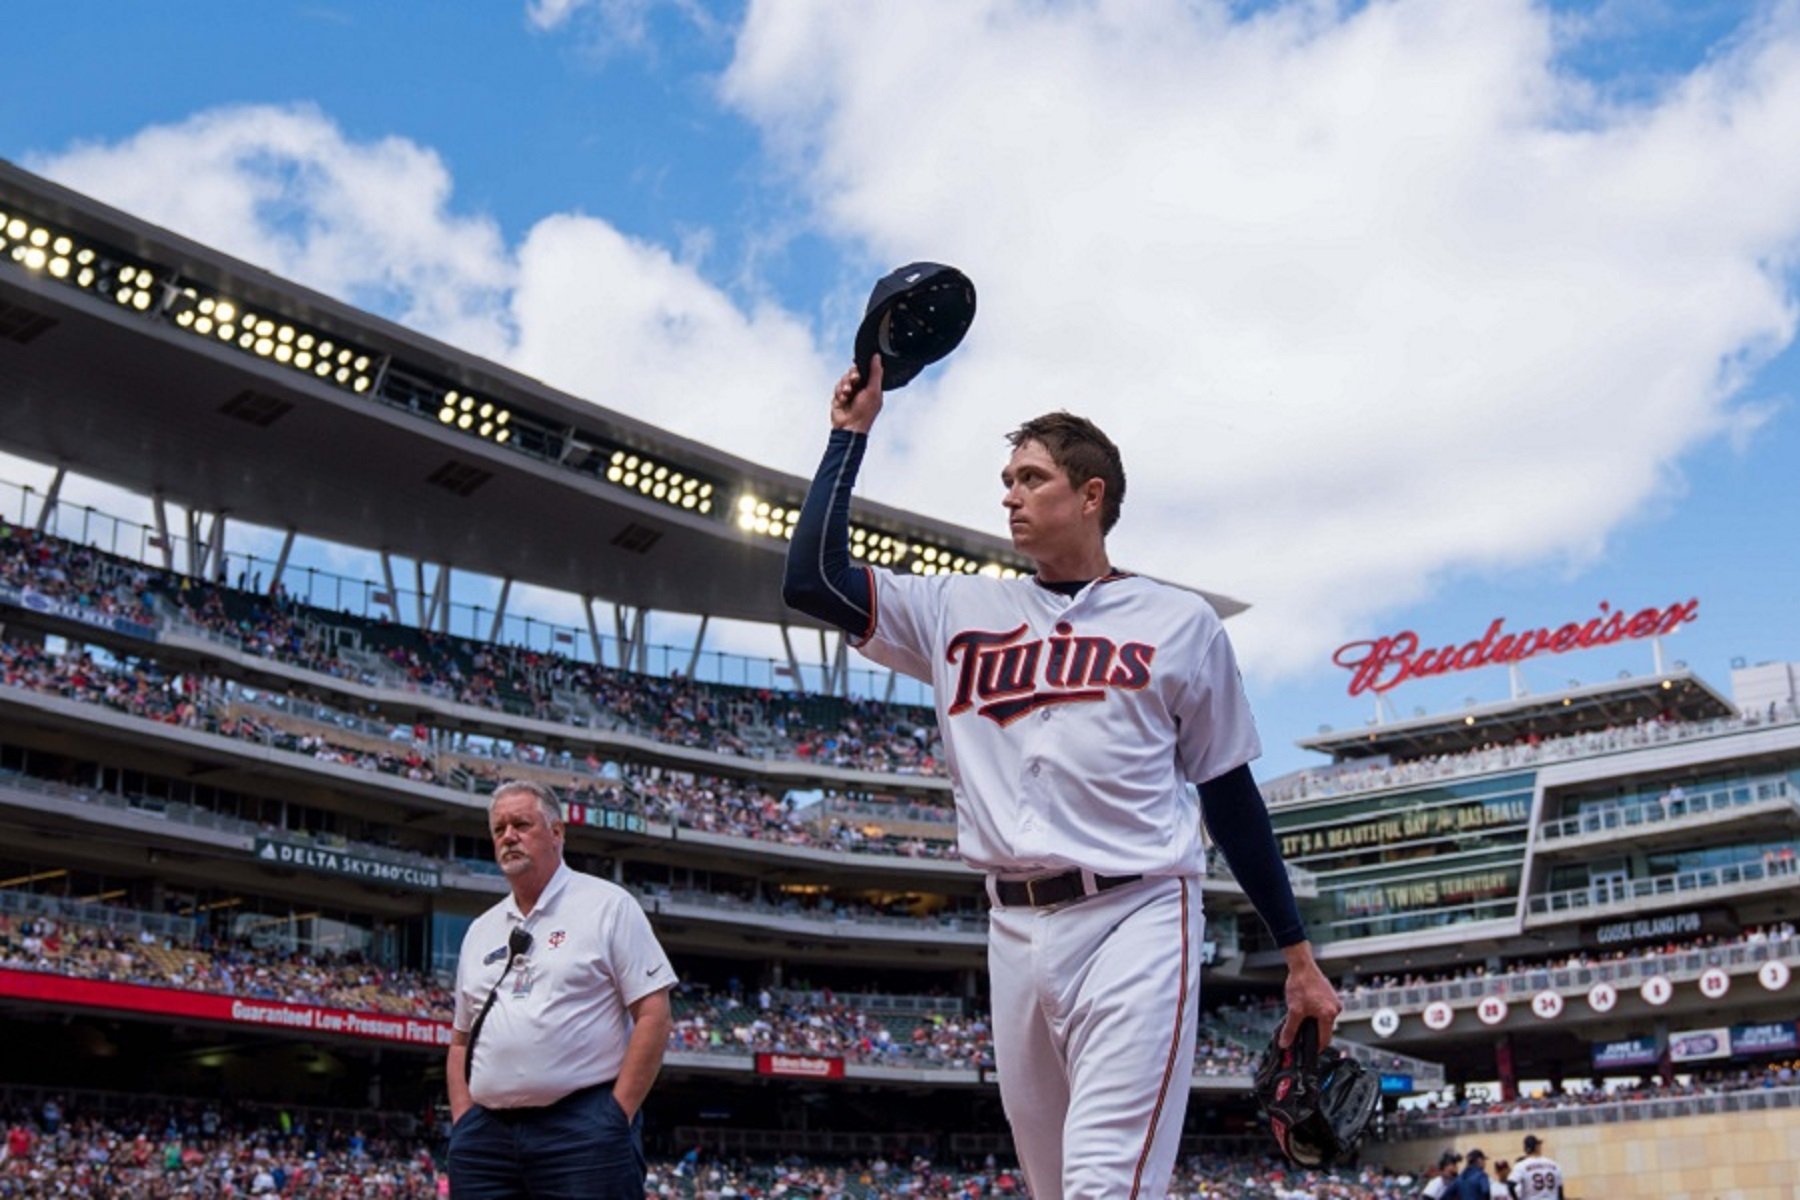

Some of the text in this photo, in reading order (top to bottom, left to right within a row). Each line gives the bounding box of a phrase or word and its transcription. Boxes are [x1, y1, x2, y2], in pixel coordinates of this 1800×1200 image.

[1333, 598, 1698, 696] Budweiser
[946, 621, 1155, 727] Twins
[1314, 831, 1325, 850] A
[1327, 819, 1402, 849] BEAUTIFUL
[1403, 811, 1428, 836] DAY
[1457, 801, 1526, 829] BASEBALL
[280, 844, 338, 870] DELTA
[404, 868, 438, 888] CLUB
[1386, 881, 1438, 908] TWINS
[1597, 912, 1700, 944] GOOSE ISLAND PUB
[232, 1000, 313, 1028] Guaranteed
[315, 1009, 404, 1039] Low-Pressure
[405, 1020, 434, 1042] First
[1532, 1172, 1556, 1191] 99
